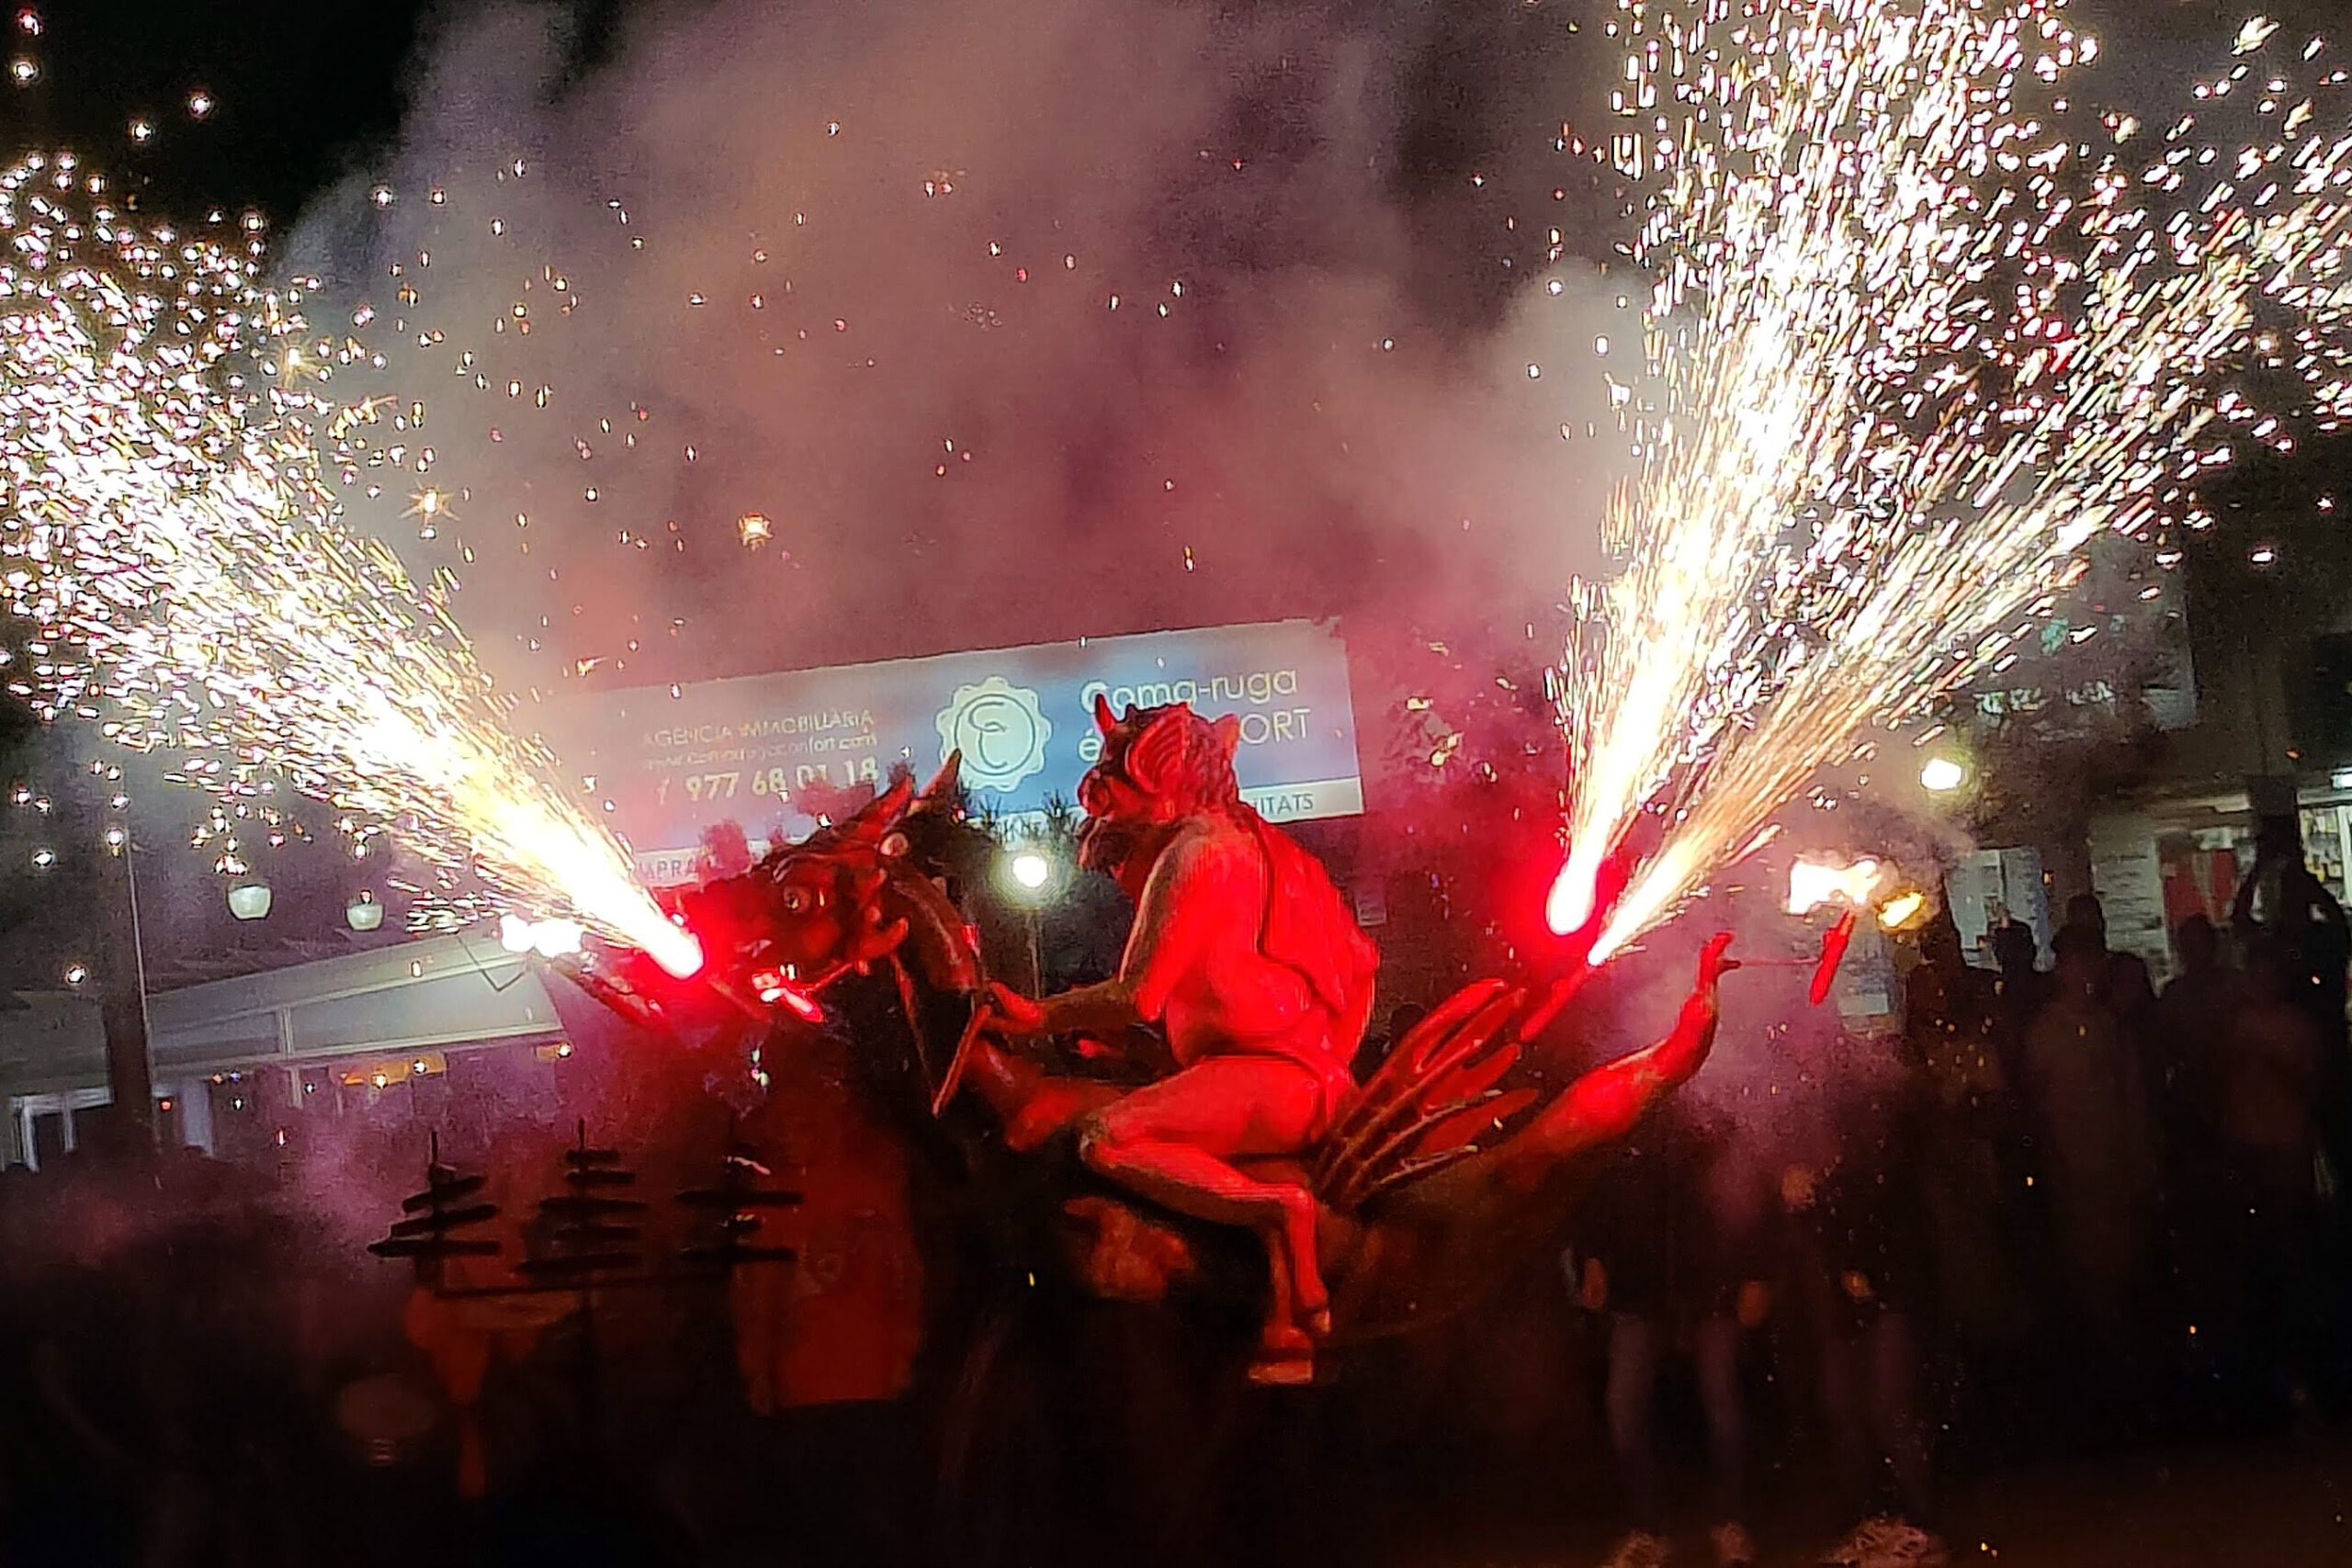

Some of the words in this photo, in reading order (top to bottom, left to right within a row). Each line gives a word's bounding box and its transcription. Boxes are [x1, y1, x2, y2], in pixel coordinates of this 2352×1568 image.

[1080, 669, 1297, 714] Coma-ruga
[1240, 707, 1311, 745] ORT
[685, 771, 740, 803] 977
[752, 767, 786, 796] 68
[843, 756, 880, 788] 18
[1253, 792, 1314, 816] ITATS
